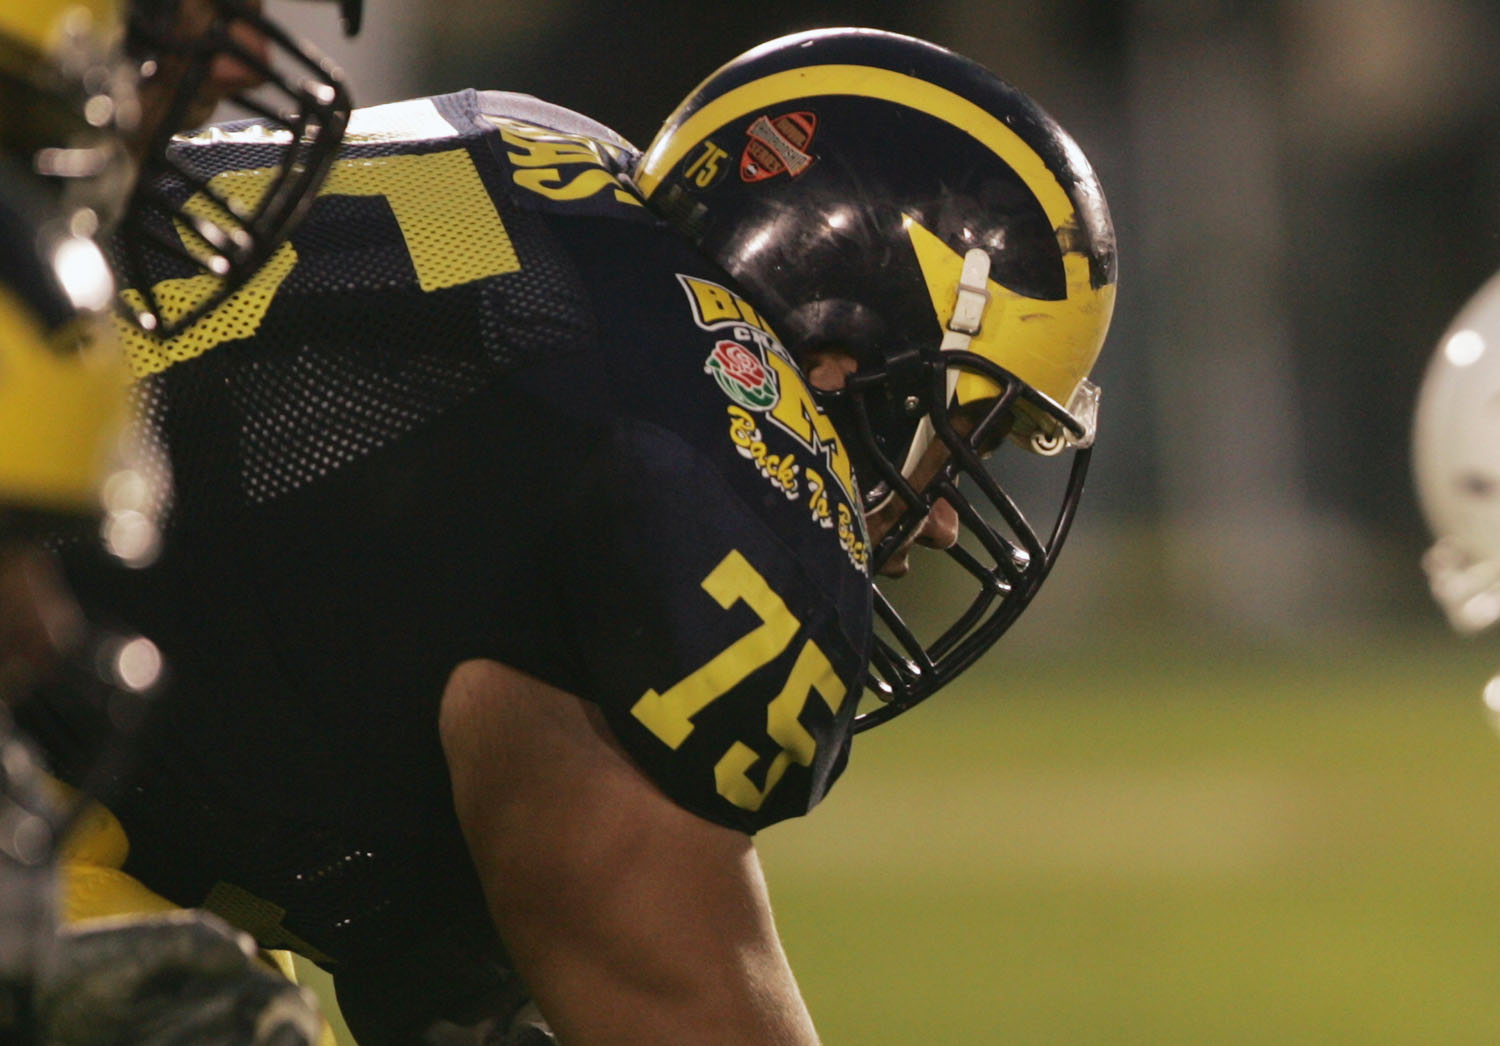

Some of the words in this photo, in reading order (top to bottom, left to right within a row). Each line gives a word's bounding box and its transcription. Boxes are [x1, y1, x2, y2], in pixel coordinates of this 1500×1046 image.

[684, 140, 729, 188] 75
[726, 404, 800, 499] Back
[630, 548, 847, 812] 75
